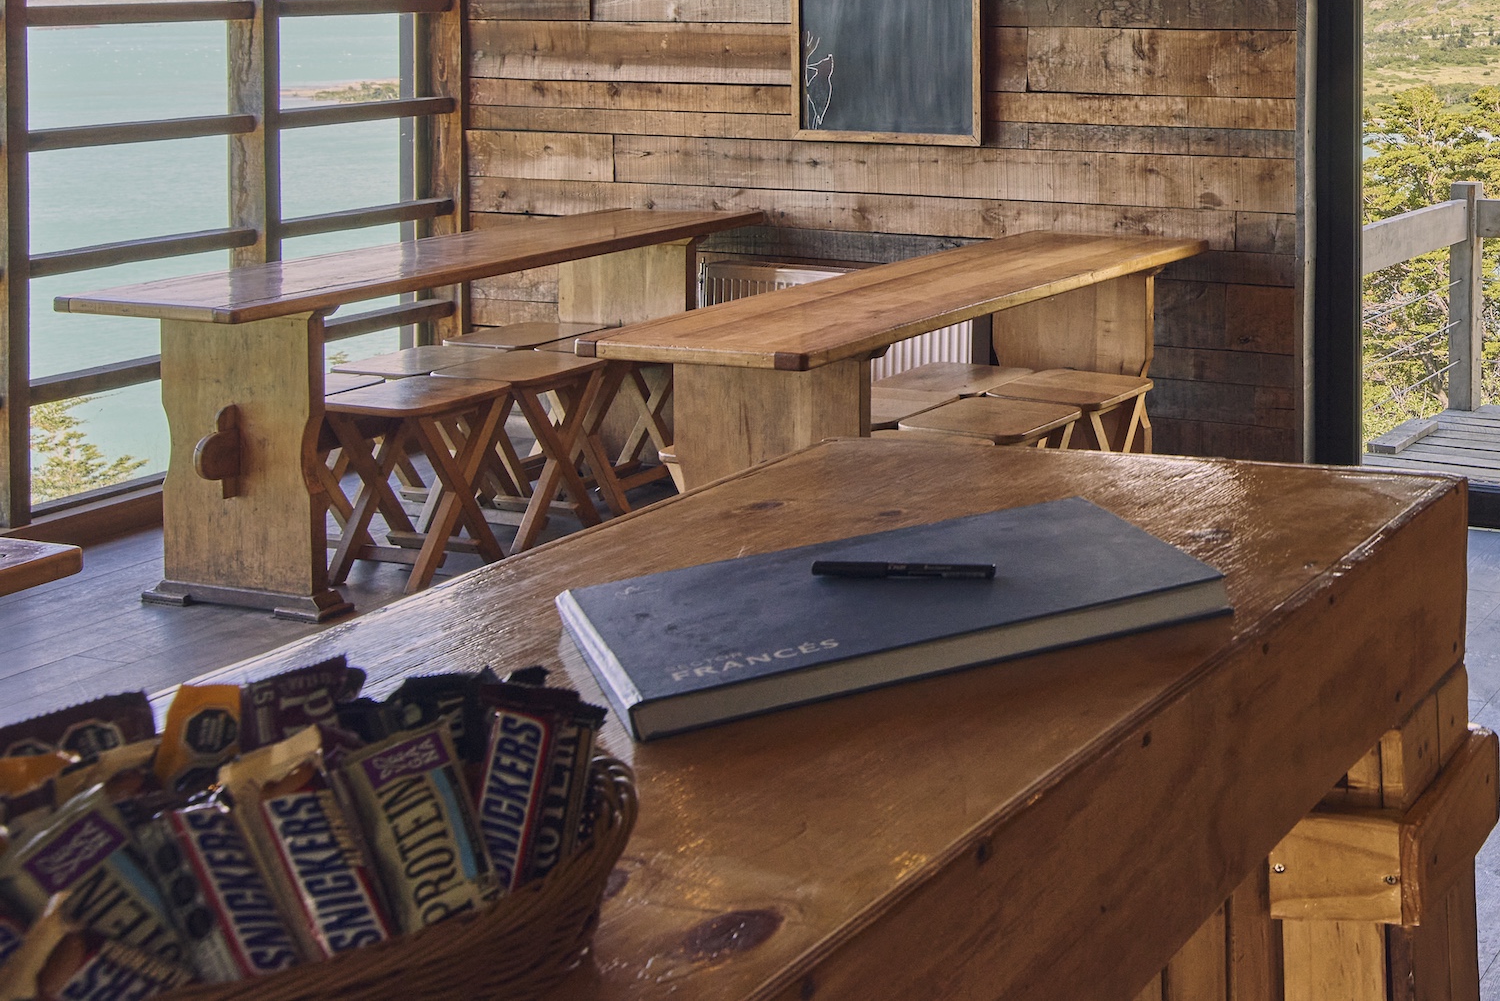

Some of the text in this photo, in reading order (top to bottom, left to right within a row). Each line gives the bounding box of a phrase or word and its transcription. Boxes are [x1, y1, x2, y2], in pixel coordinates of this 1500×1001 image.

[671, 637, 840, 682] FRANCÉS
[187, 812, 296, 971] SNICKERS
[270, 795, 383, 952] SNICKERS
[375, 775, 475, 925] PROTEIN
